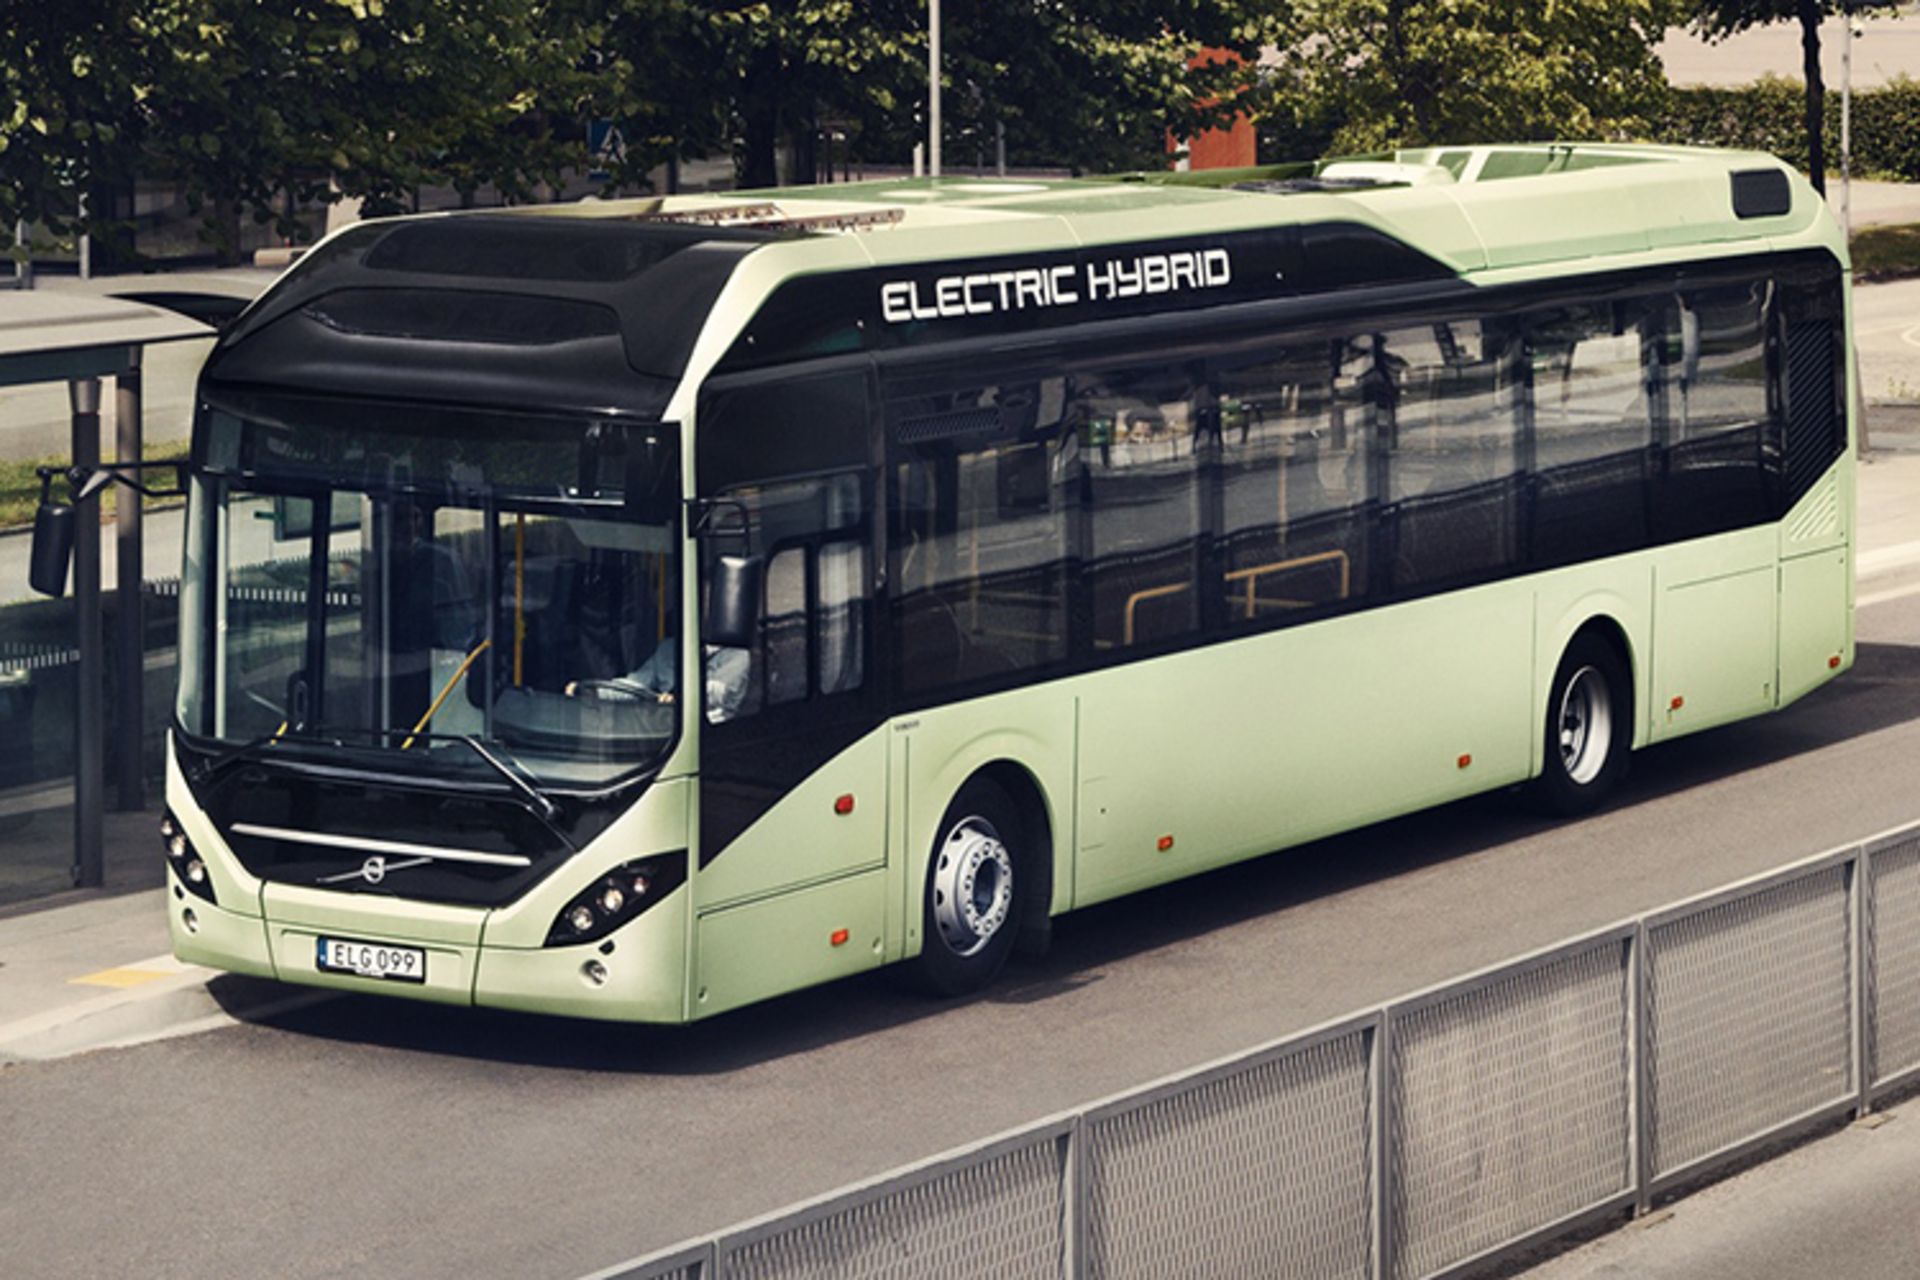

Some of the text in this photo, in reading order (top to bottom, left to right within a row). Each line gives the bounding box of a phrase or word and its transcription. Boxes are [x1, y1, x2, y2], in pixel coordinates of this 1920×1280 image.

[881, 249, 1231, 322] ELECTRIC HYBRID
[334, 944, 416, 973] ELG 099
